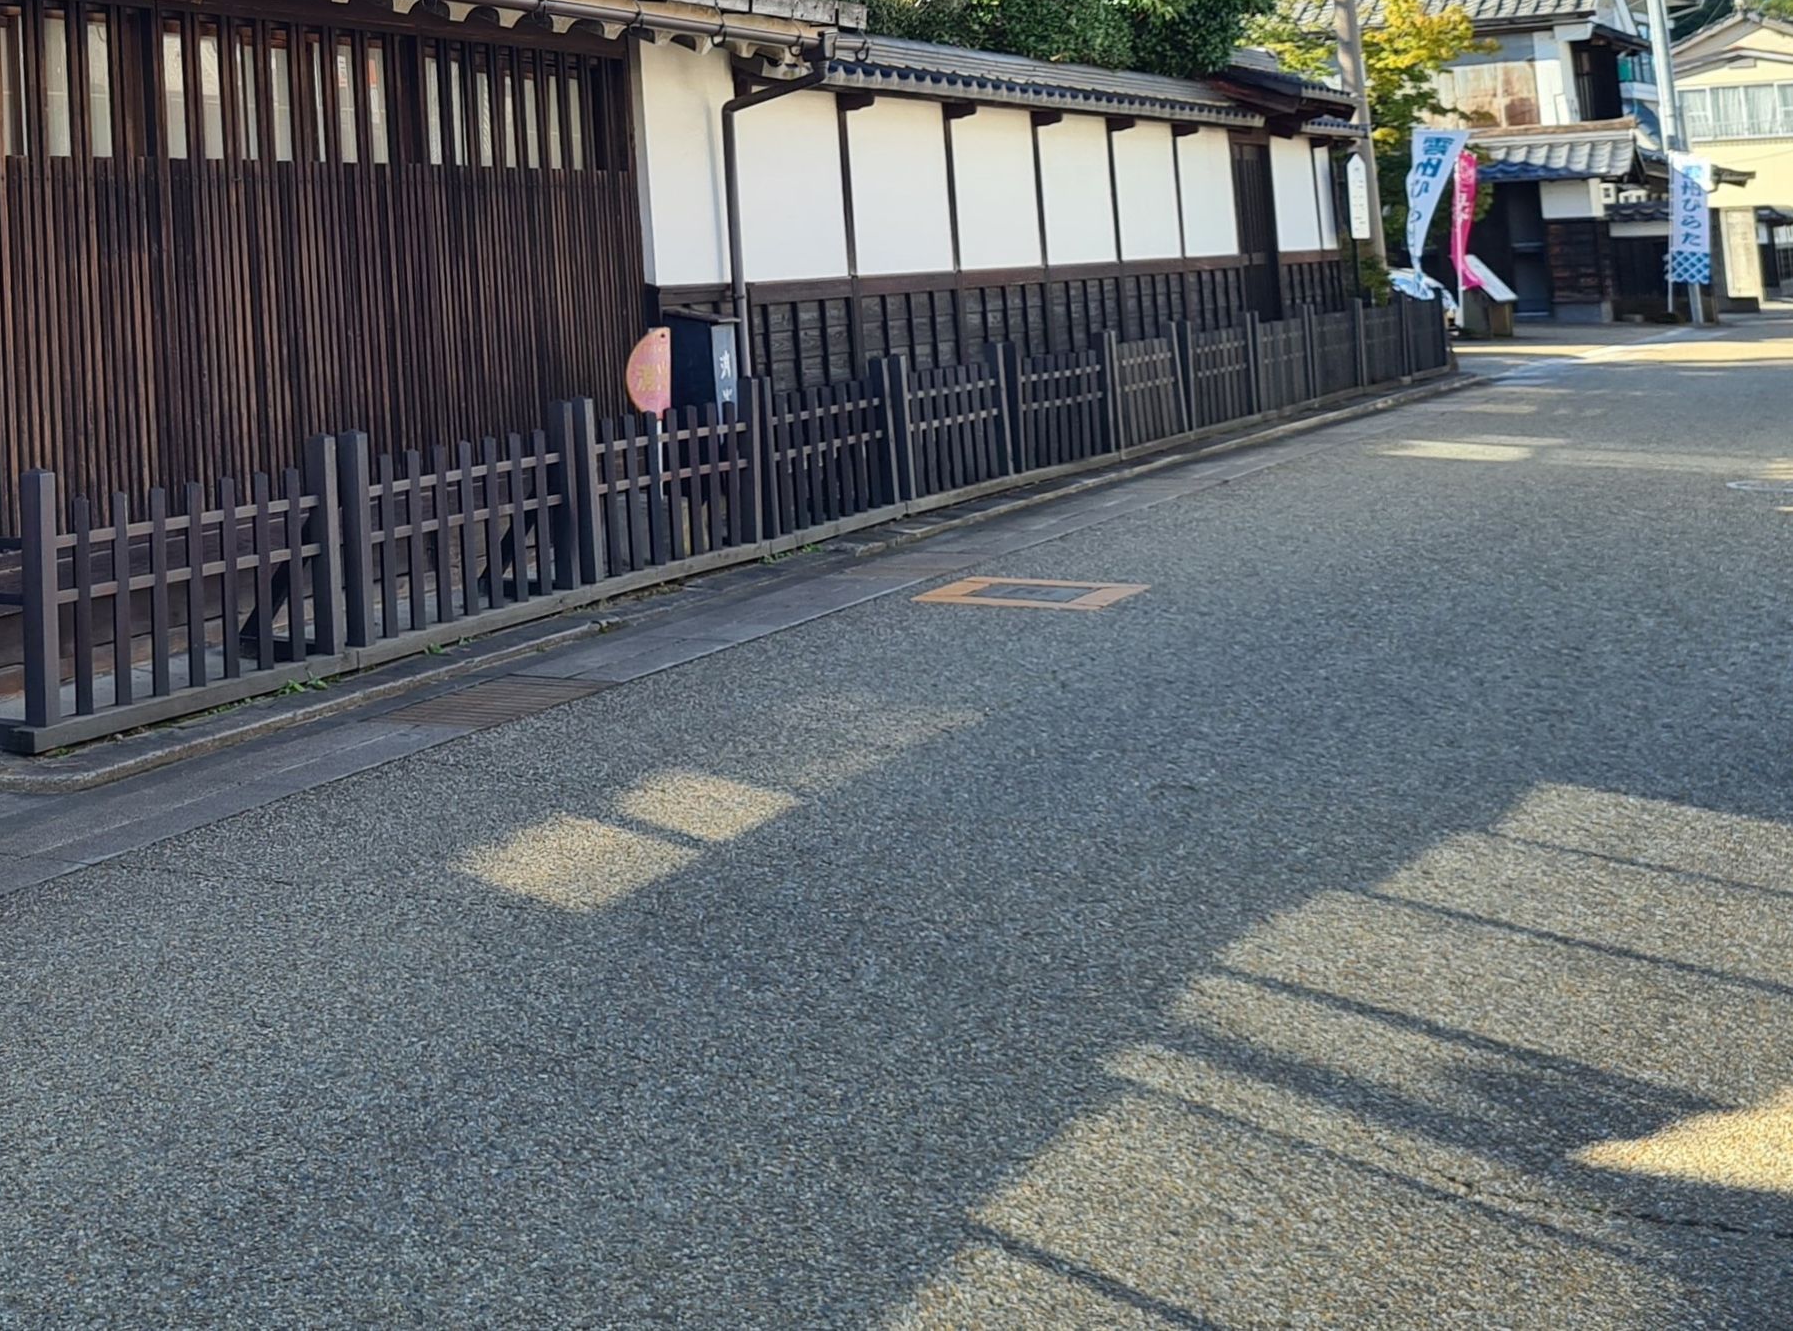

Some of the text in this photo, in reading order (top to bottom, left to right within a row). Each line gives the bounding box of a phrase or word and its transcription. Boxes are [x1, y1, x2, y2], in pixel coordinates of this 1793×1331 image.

[1680, 164, 1702, 247] 雲州ひらた
